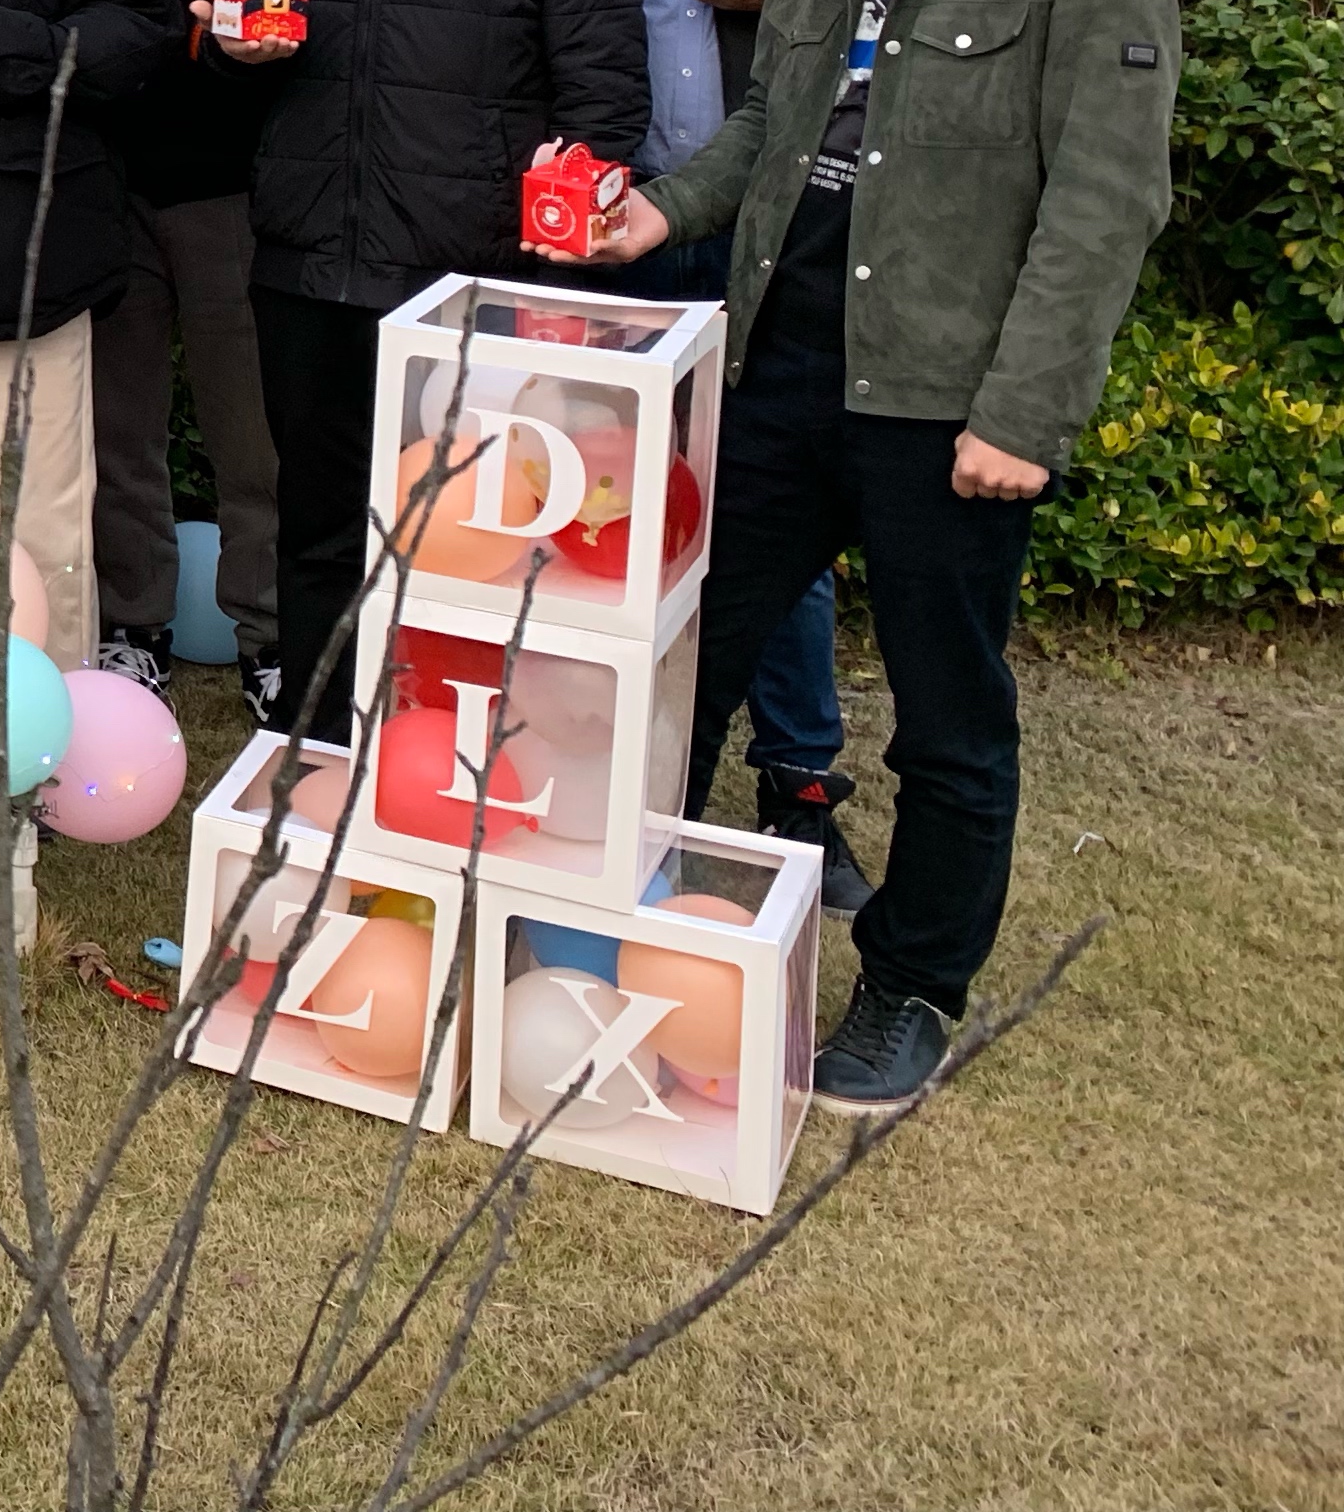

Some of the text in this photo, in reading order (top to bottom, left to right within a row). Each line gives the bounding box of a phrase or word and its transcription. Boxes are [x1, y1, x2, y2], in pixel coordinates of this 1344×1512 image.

[457, 407, 586, 539] D
[436, 678, 556, 819] L
[272, 900, 374, 1031] Z
[545, 976, 686, 1124] X
